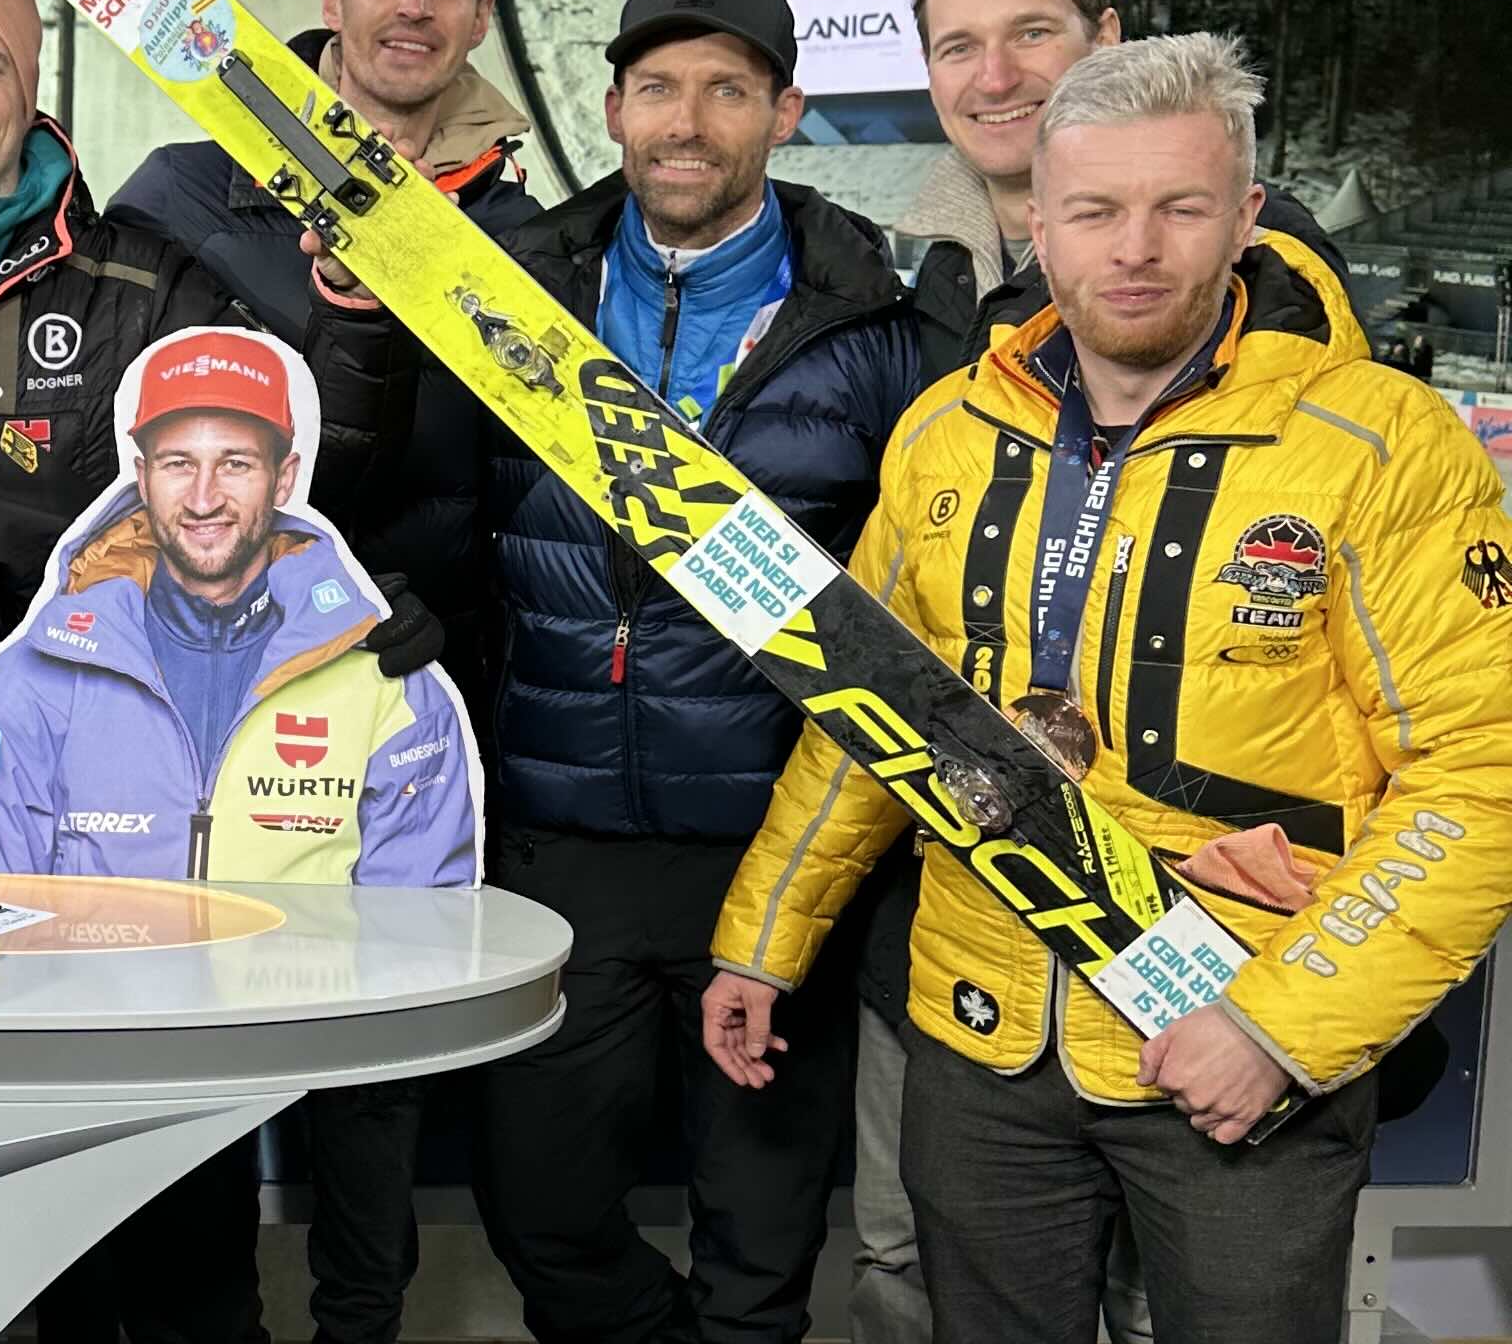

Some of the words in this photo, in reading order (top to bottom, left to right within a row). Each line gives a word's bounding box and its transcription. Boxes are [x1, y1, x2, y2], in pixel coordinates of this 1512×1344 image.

[27, 373, 83, 390] BOGNER
[160, 355, 269, 386] VIESSMANN
[738, 504, 781, 549] WER
[776, 543, 800, 566] SI
[1066, 513, 1101, 578] SOCHI
[1085, 461, 1115, 510] 2014
[704, 536, 749, 584] WAR
[744, 578, 787, 618] NED
[719, 521, 807, 602] ERINNERT
[1236, 607, 1301, 626] TEAM
[248, 776, 355, 798] WÜRTH
[68, 812, 156, 833] TERREX
[1281, 810, 1466, 977] TEAM
[1147, 936, 1193, 979] NED
[1191, 942, 1236, 982] BEI!
[1126, 952, 1199, 1015] NNERT
[1132, 990, 1159, 1013] SI
[1189, 973, 1219, 1003] AR
